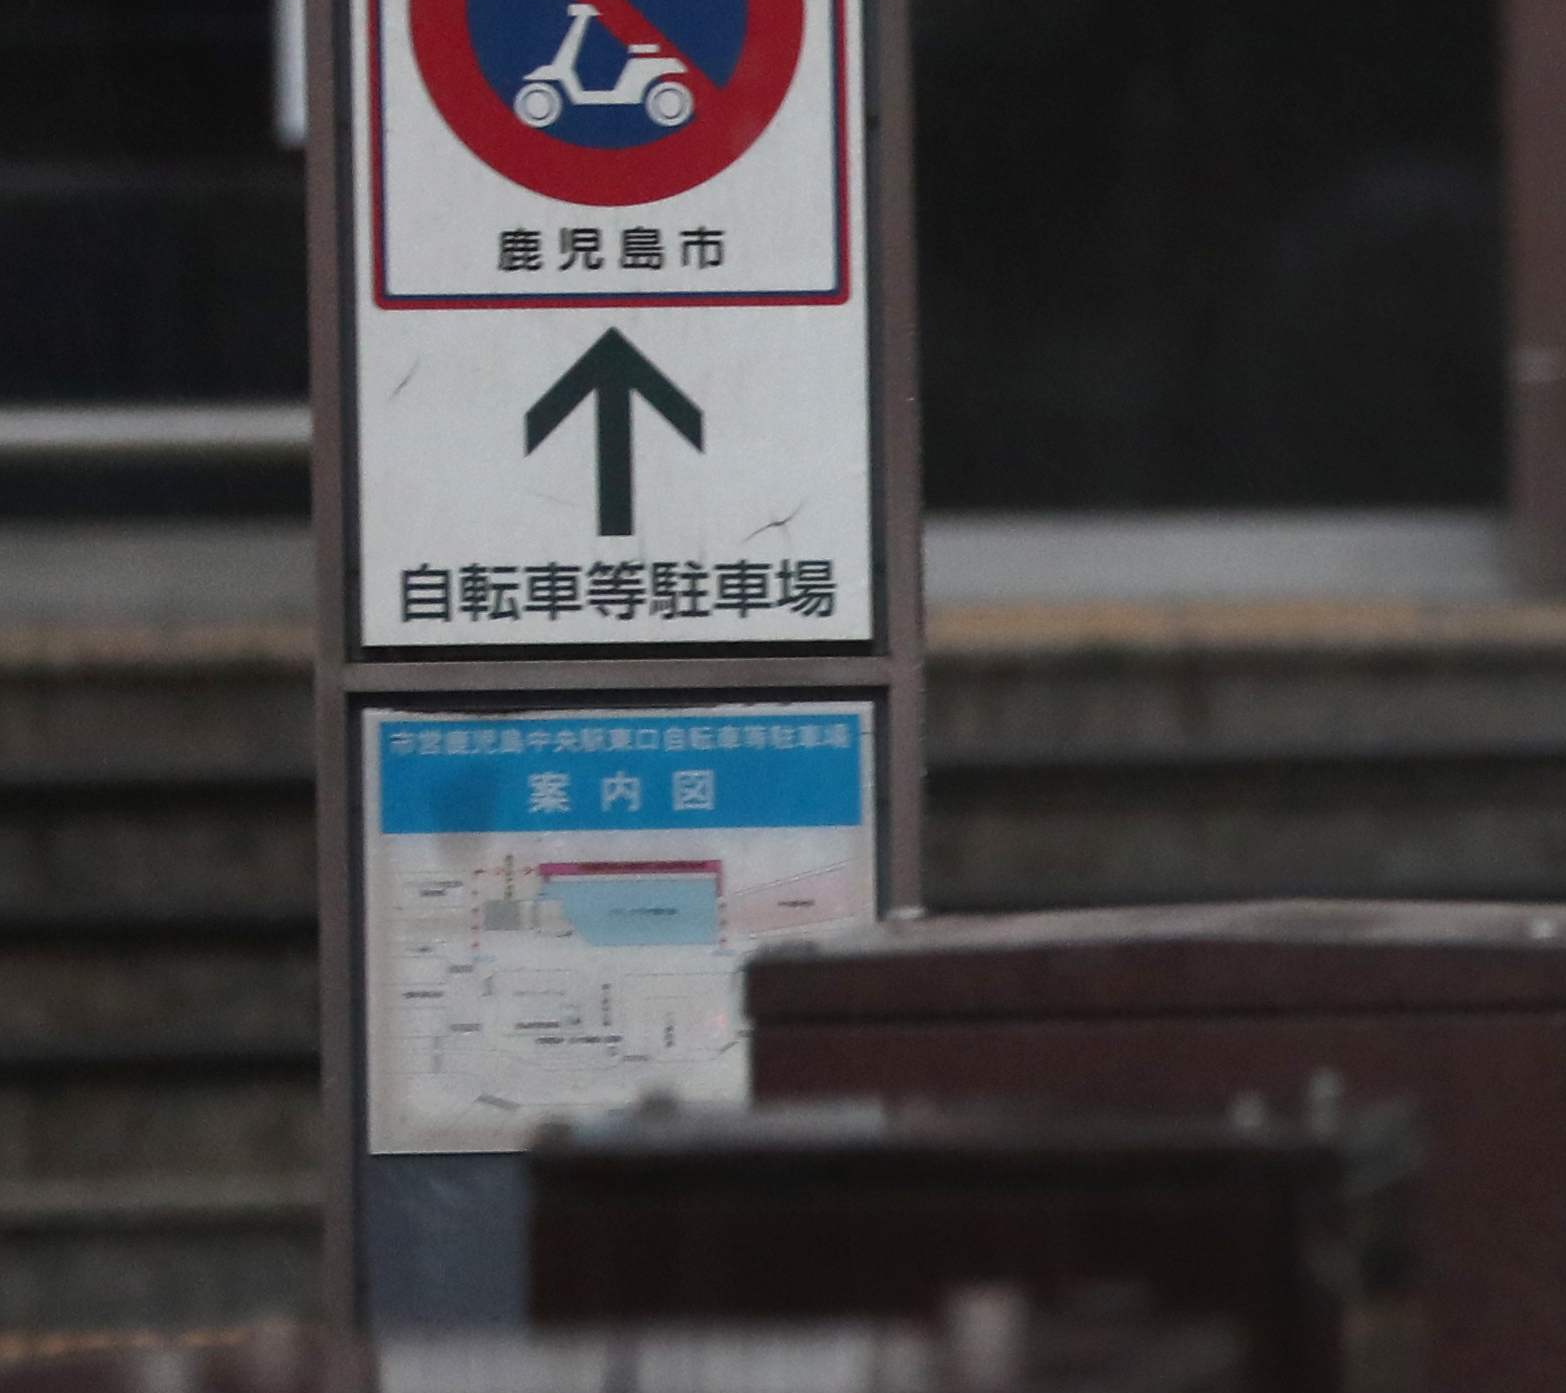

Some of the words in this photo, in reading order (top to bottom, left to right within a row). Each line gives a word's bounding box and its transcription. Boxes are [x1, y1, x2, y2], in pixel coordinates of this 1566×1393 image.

[497, 227, 726, 273] 鹿児島市
[402, 559, 839, 623] 自転車等駐車場
[528, 769, 716, 813] 案内図
